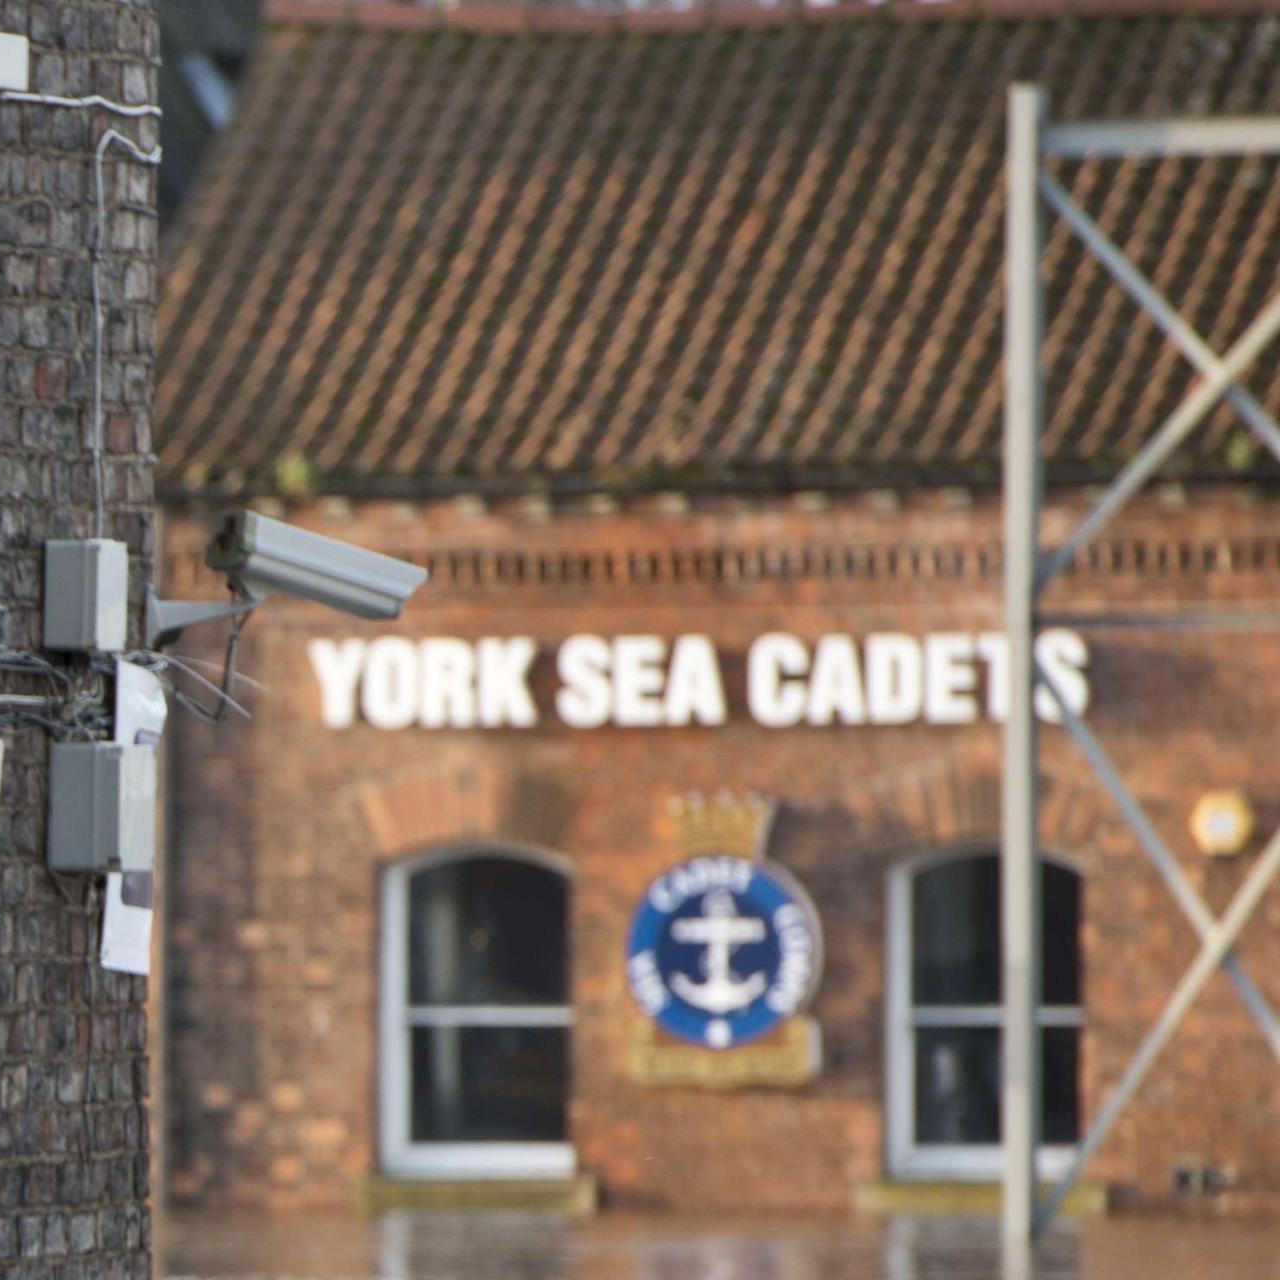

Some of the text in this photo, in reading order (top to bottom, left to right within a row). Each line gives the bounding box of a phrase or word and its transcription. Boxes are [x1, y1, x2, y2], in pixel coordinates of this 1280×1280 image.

[307, 628, 1088, 730] YORK SEA CADETS
